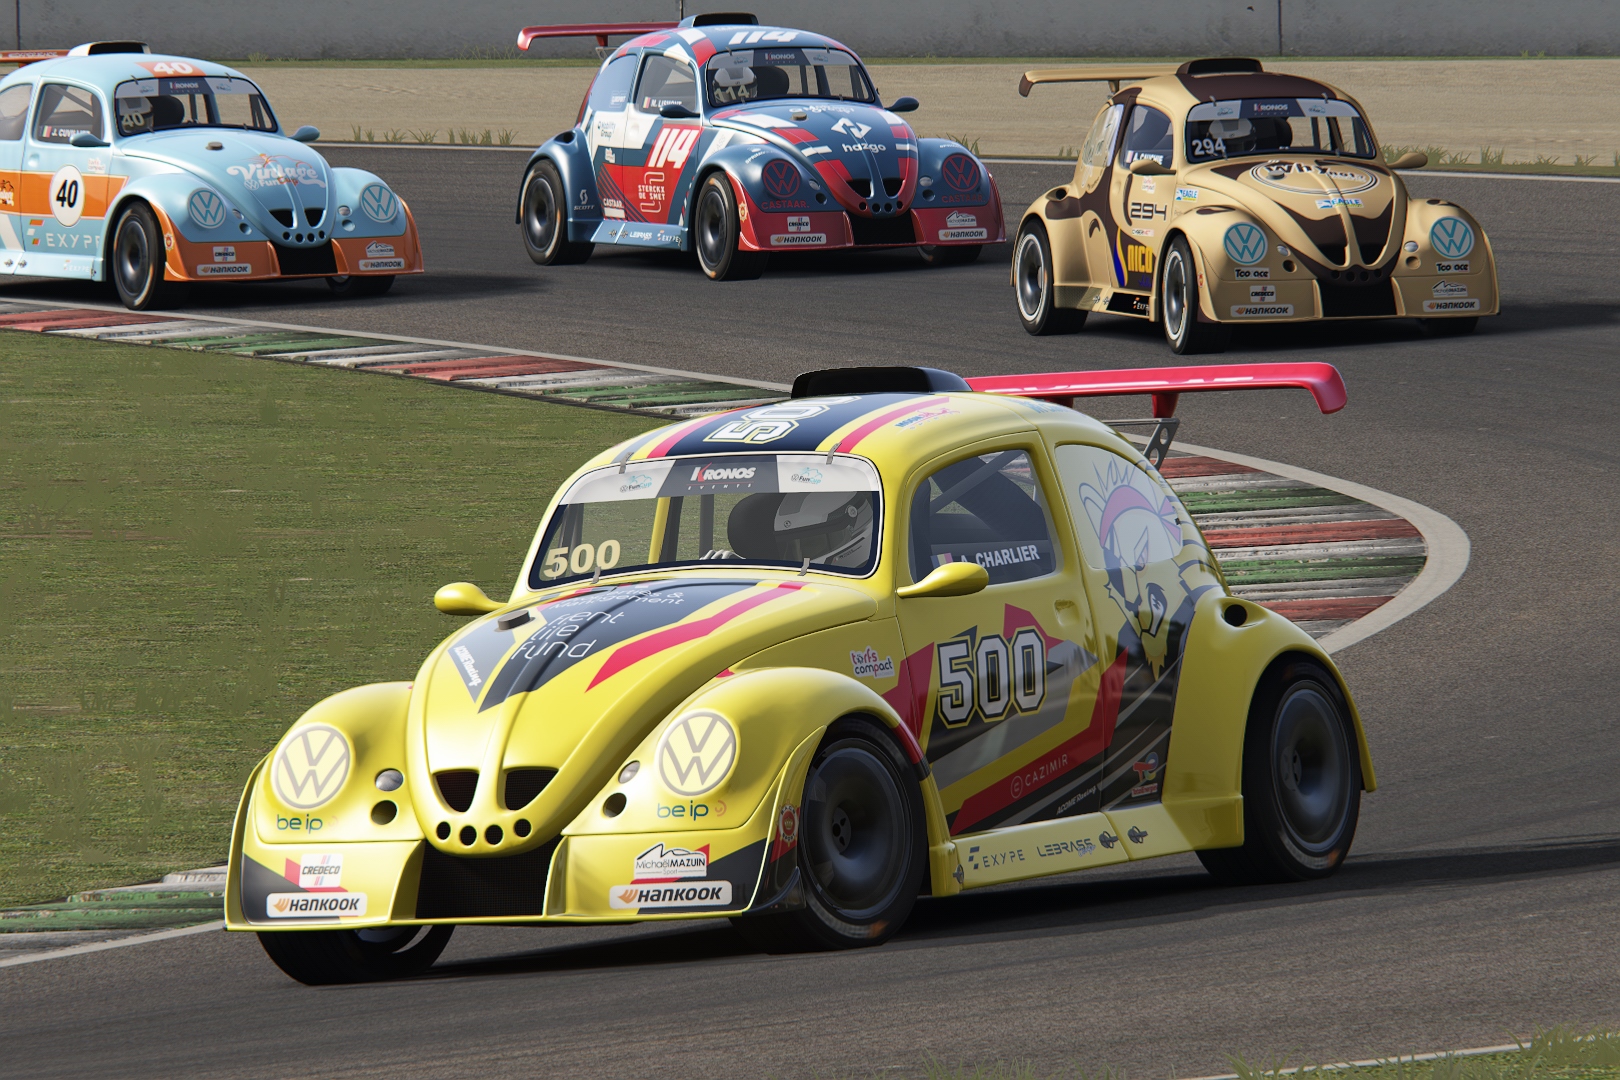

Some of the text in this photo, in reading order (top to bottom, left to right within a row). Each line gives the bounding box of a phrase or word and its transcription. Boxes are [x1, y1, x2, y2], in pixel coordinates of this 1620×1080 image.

[728, 30, 799, 45] 114
[153, 62, 194, 75] 40
[714, 85, 750, 100] 114
[1254, 103, 1287, 112] KRONOS
[122, 113, 145, 127] 40
[648, 128, 699, 169] 114
[842, 144, 886, 154] hazgo
[1192, 138, 1226, 156] 294
[226, 163, 326, 188] Vintage
[56, 179, 79, 208] 40
[1182, 189, 1198, 198] EAGLE
[1131, 202, 1167, 221] 294
[692, 462, 757, 482] KRONOS
[688, 482, 753, 491] EVENTS
[542, 539, 621, 579] 500
[975, 545, 1040, 568] CHARLIER
[511, 639, 598, 660] fund
[855, 657, 893, 677] compact
[938, 627, 1047, 728] 500
[1024, 753, 1069, 788] CAZIMIR
[657, 802, 685, 819] be
[276, 814, 302, 831] be
[669, 857, 706, 868] MAZUIN
[982, 838, 1093, 869] EXYPE LEBRASS
[301, 865, 341, 876] CREDECO
